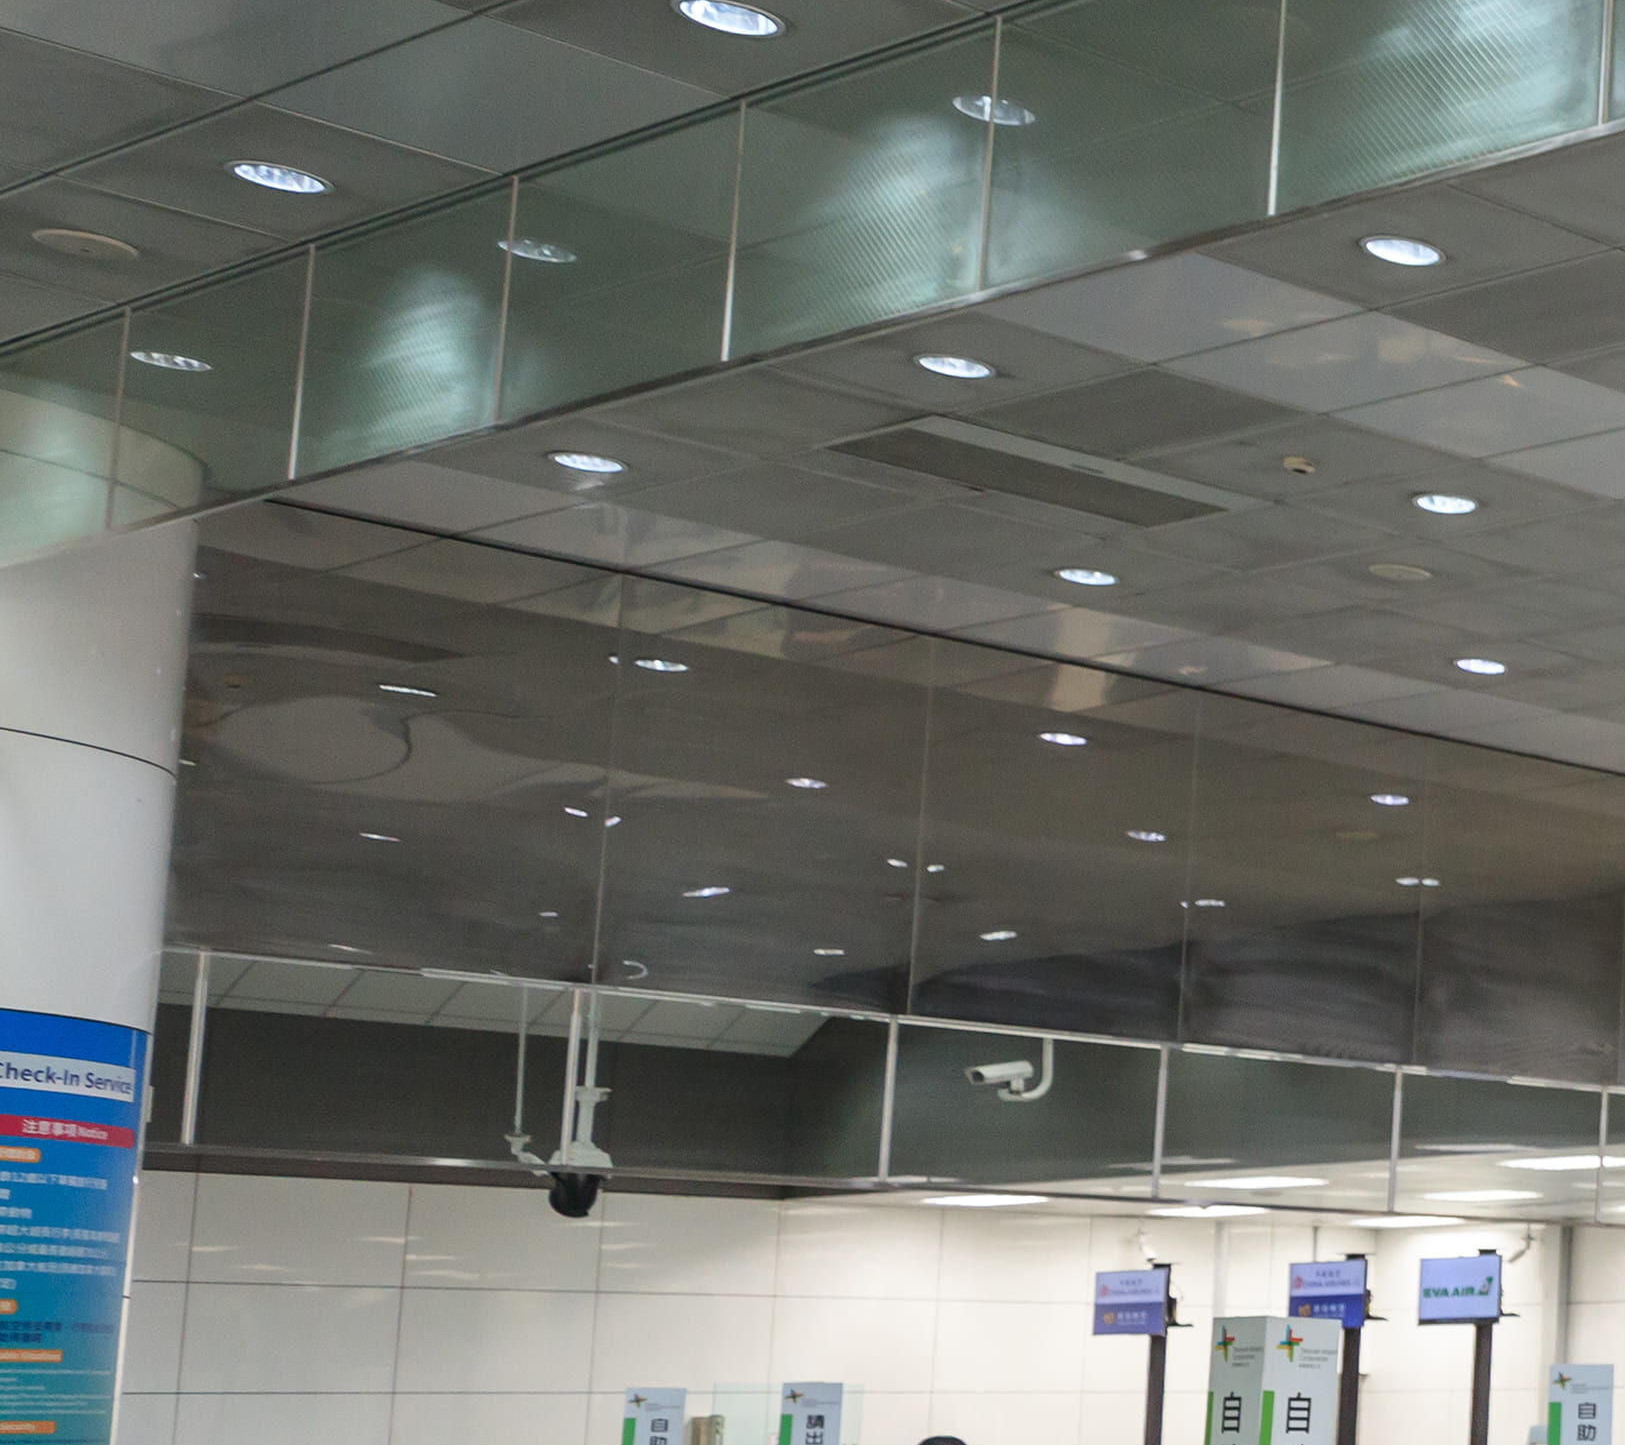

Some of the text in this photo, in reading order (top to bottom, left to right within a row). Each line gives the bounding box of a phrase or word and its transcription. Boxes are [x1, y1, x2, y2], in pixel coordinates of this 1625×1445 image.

[85, 1072, 132, 1094] Service
[1423, 1286, 1474, 1298] EVA AIR
